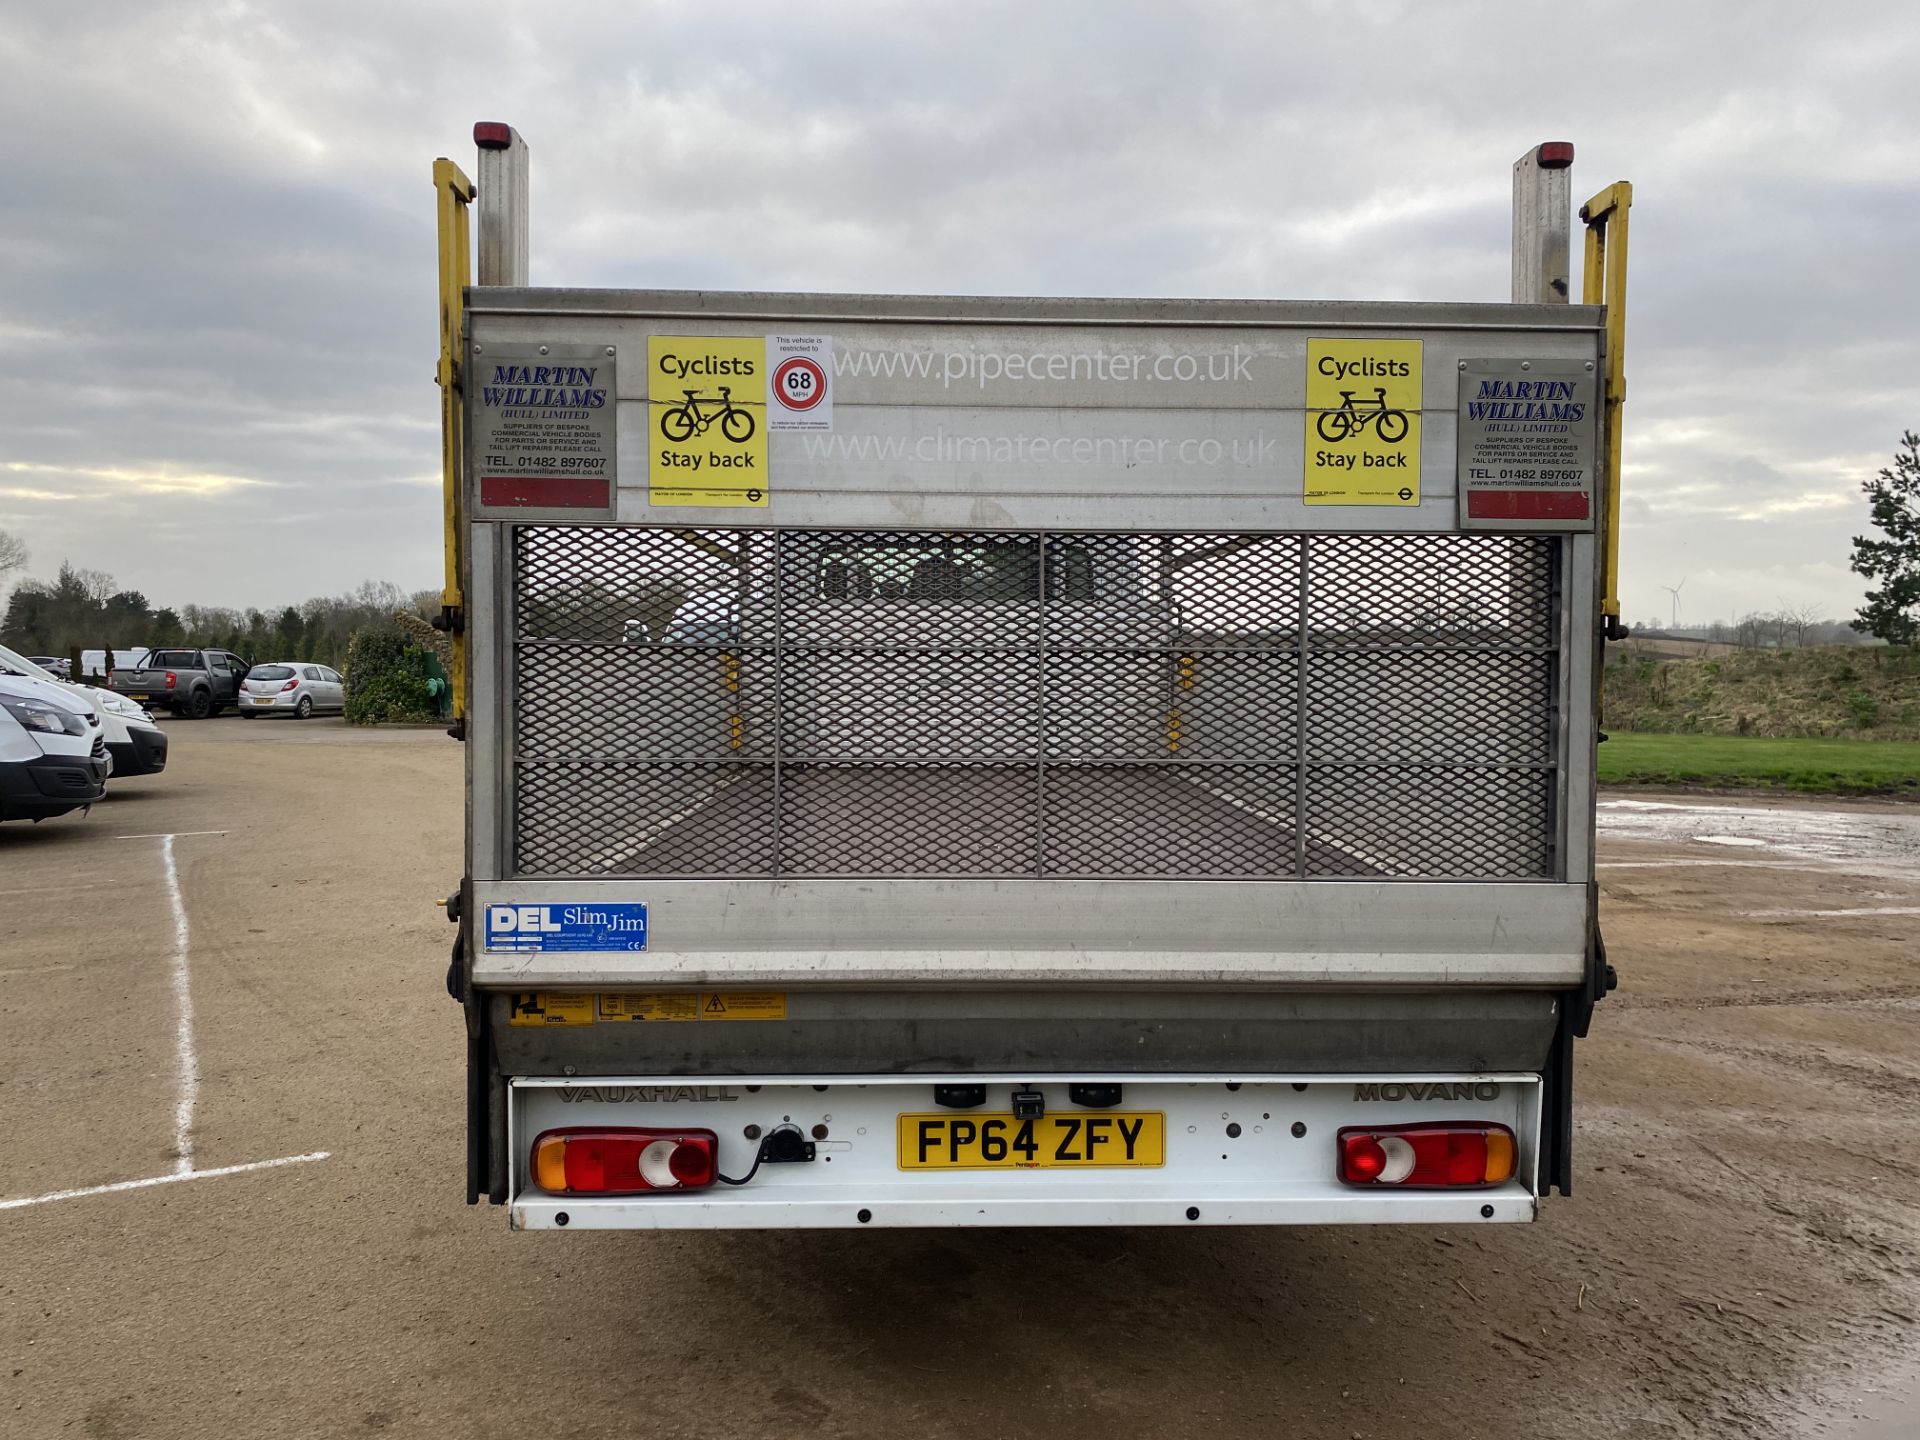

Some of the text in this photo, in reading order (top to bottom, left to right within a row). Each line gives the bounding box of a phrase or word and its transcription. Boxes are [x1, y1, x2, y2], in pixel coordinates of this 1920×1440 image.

[492, 366, 597, 386] MARTIN
[660, 354, 754, 379] Cyclists
[830, 344, 1254, 389] www.pipecenter.co.uk
[1318, 356, 1410, 380] Cyclists
[788, 372, 811, 389] 68
[1477, 380, 1576, 400] MARTIN
[483, 387, 607, 408] WILLIAMS
[501, 410, 589, 419] (HULL) LIMITED
[1468, 402, 1585, 422] WILLIAMS
[1484, 424, 1568, 432] (HULL) LIMITED
[802, 426, 1276, 465] www.climatecenter.couk
[485, 456, 606, 468] TEL. 01482 897607
[661, 450, 754, 471] Stay back
[1316, 450, 1407, 471] Stay back
[487, 467, 604, 475] www.martinwilliamshull.co.uk
[1469, 468, 1583, 480] TEL. 01482 897607
[491, 907, 561, 932] DEL
[564, 907, 645, 931] Slim Jim
[553, 1086, 739, 1103] VAUXHALL
[1353, 1083, 1500, 1102] MOVANO
[918, 1119, 1144, 1162] FP64 ZFY
